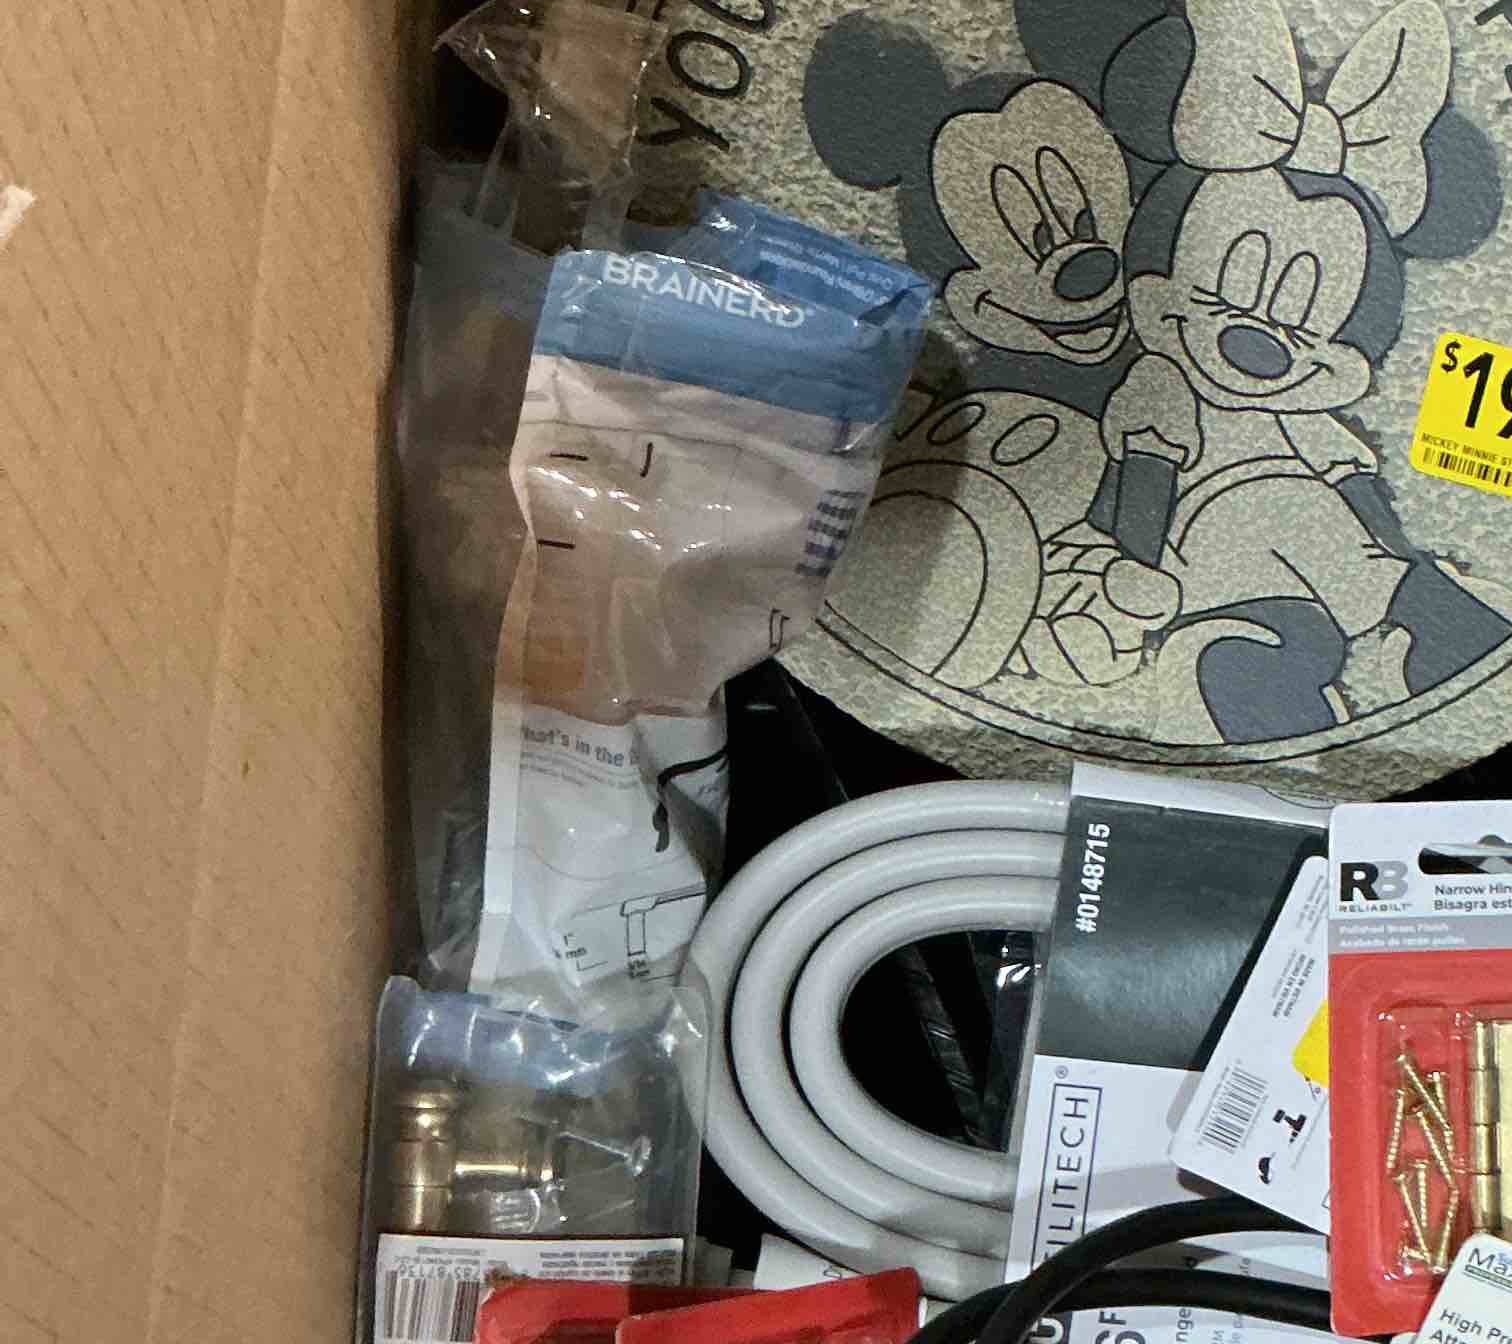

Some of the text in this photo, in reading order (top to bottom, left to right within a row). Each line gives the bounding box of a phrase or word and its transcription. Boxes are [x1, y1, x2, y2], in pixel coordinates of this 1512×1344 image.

[601, 255, 806, 329] BRAINERD
[1074, 823, 1111, 934] #0148715
[1434, 883, 1485, 897] Narrow
[1434, 898, 1489, 912] Bisagra
[1045, 1096, 1091, 1252] ILITECH
[1440, 1308, 1483, 1335] High
